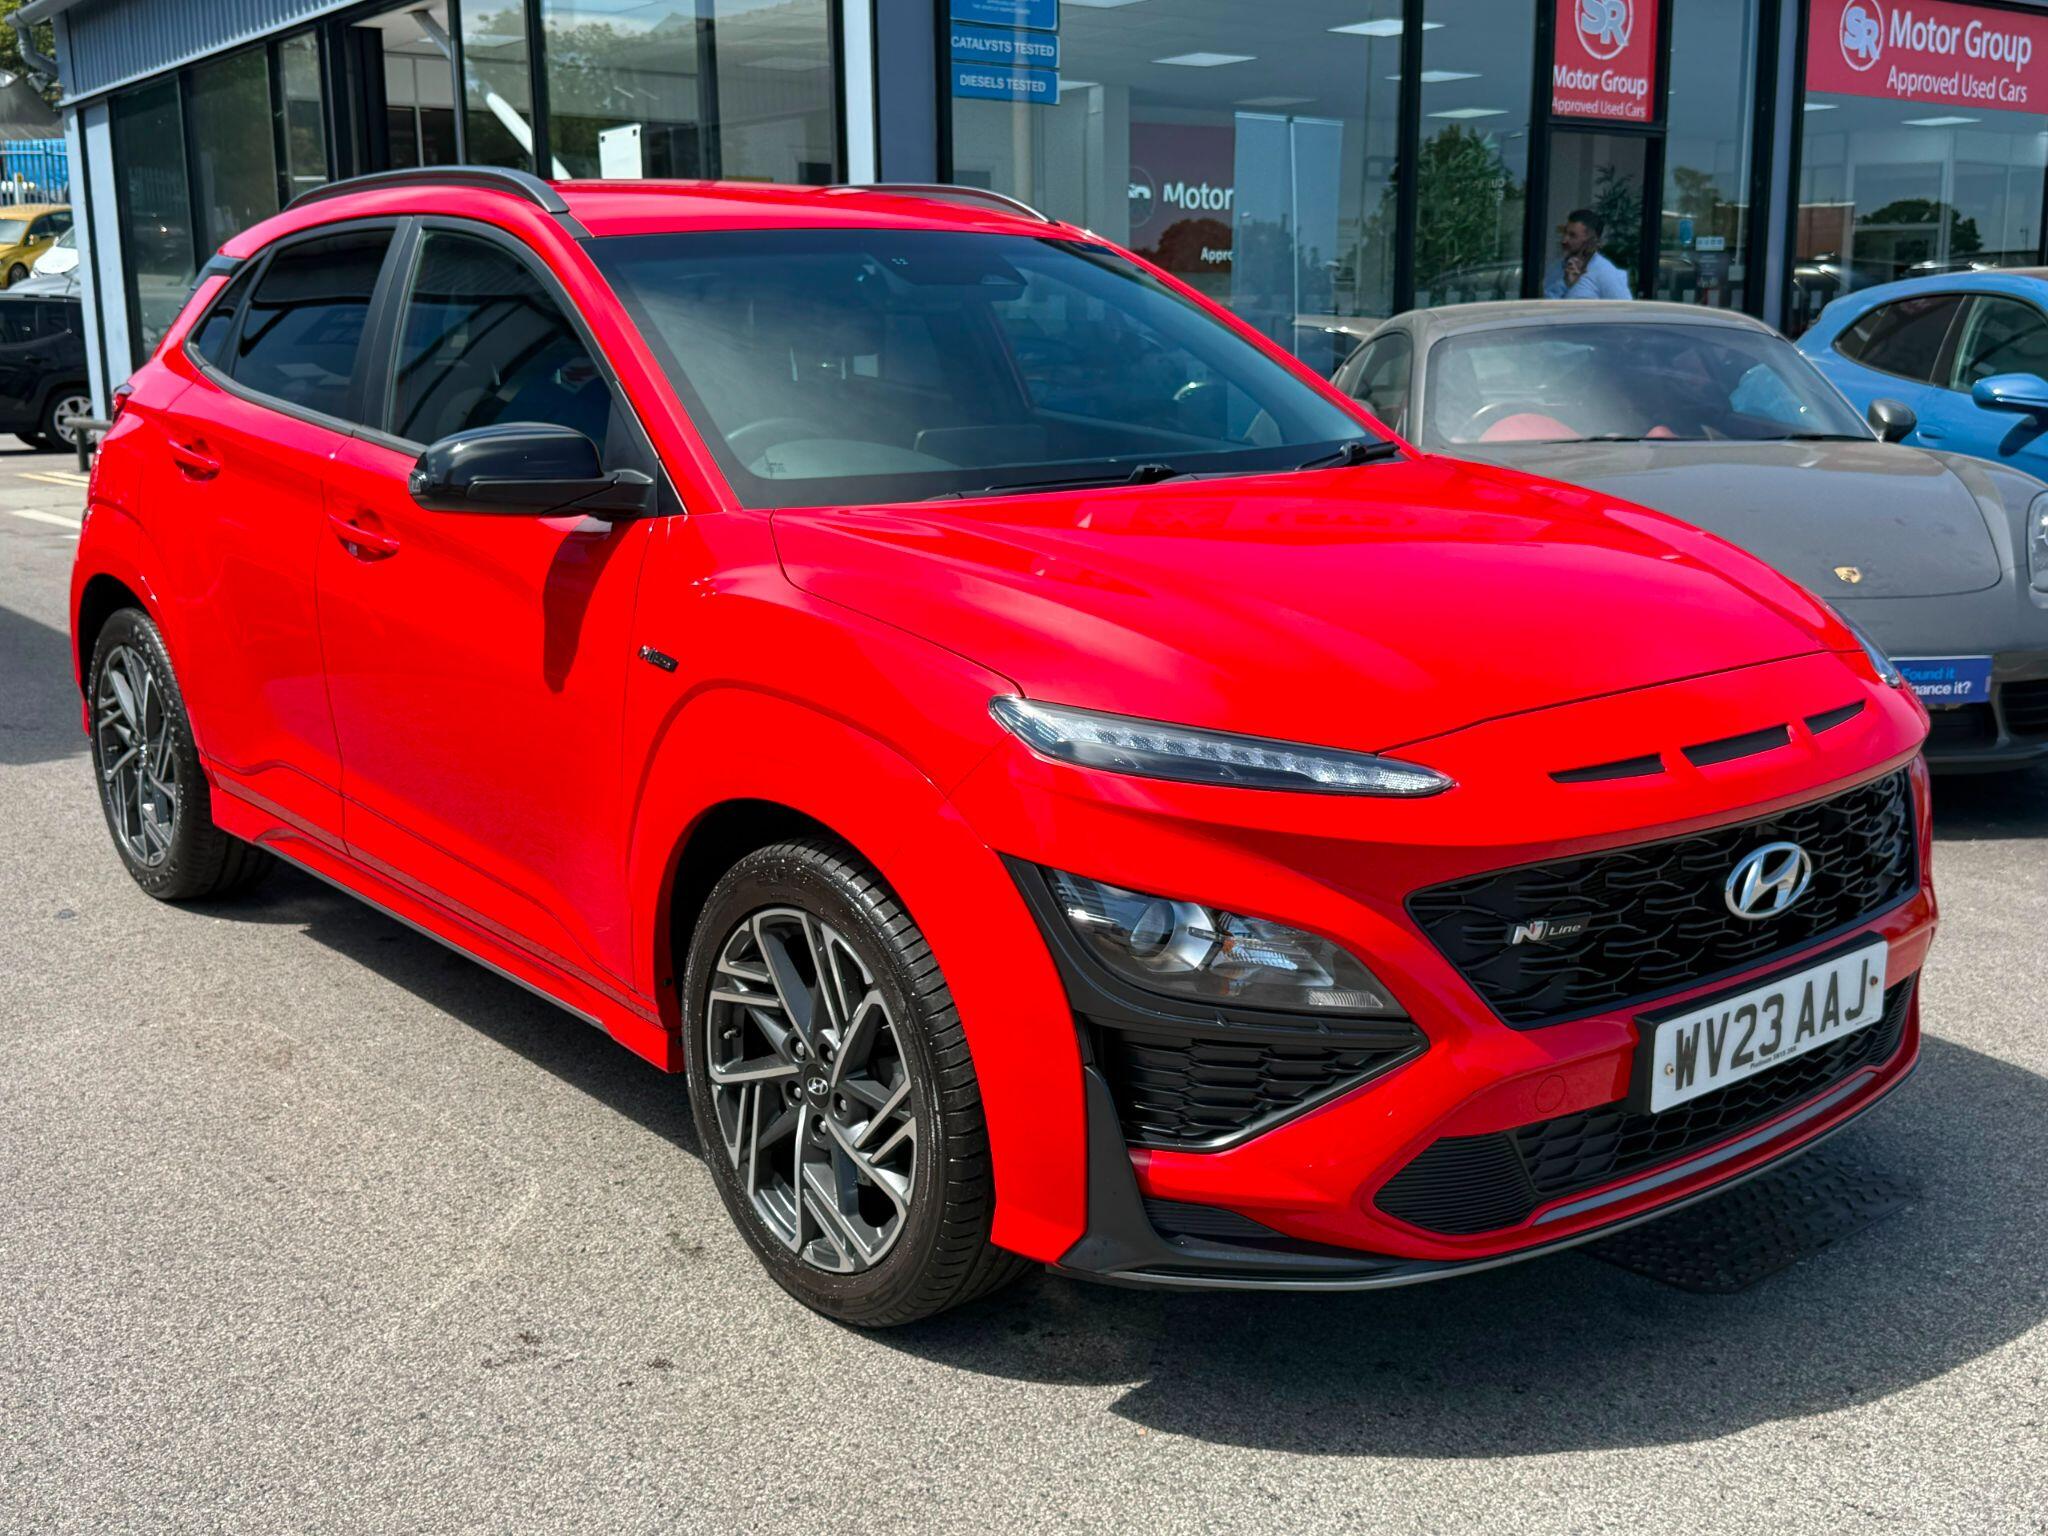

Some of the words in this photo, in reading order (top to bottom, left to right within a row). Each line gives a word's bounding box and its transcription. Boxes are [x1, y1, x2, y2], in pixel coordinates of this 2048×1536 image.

[951, 36, 1013, 53] CATALYSTS
[1014, 41, 1055, 57] TESTED
[1888, 8, 1961, 56] Motor
[1964, 19, 2032, 74] Group
[960, 74, 1005, 90] DIESELS
[1006, 78, 1047, 93] TESTED
[1553, 64, 1600, 91] Motor
[1601, 69, 1648, 101] Group
[1886, 64, 1959, 97] Approved
[1961, 74, 1997, 100] Used
[1998, 77, 2028, 104] Cars
[1552, 97, 1599, 114] Approved
[1600, 100, 1624, 116] Used
[1625, 102, 1646, 118] Cars
[1163, 181, 1234, 210] Motor
[1902, 667, 1943, 680] Found
[1946, 667, 1955, 680] it
[1909, 682, 1952, 695] nance
[1953, 680, 1972, 695] it?
[1548, 925, 1582, 936] Line
[1675, 992, 1785, 1091] WV23
[1794, 958, 1869, 1044] AAJ
